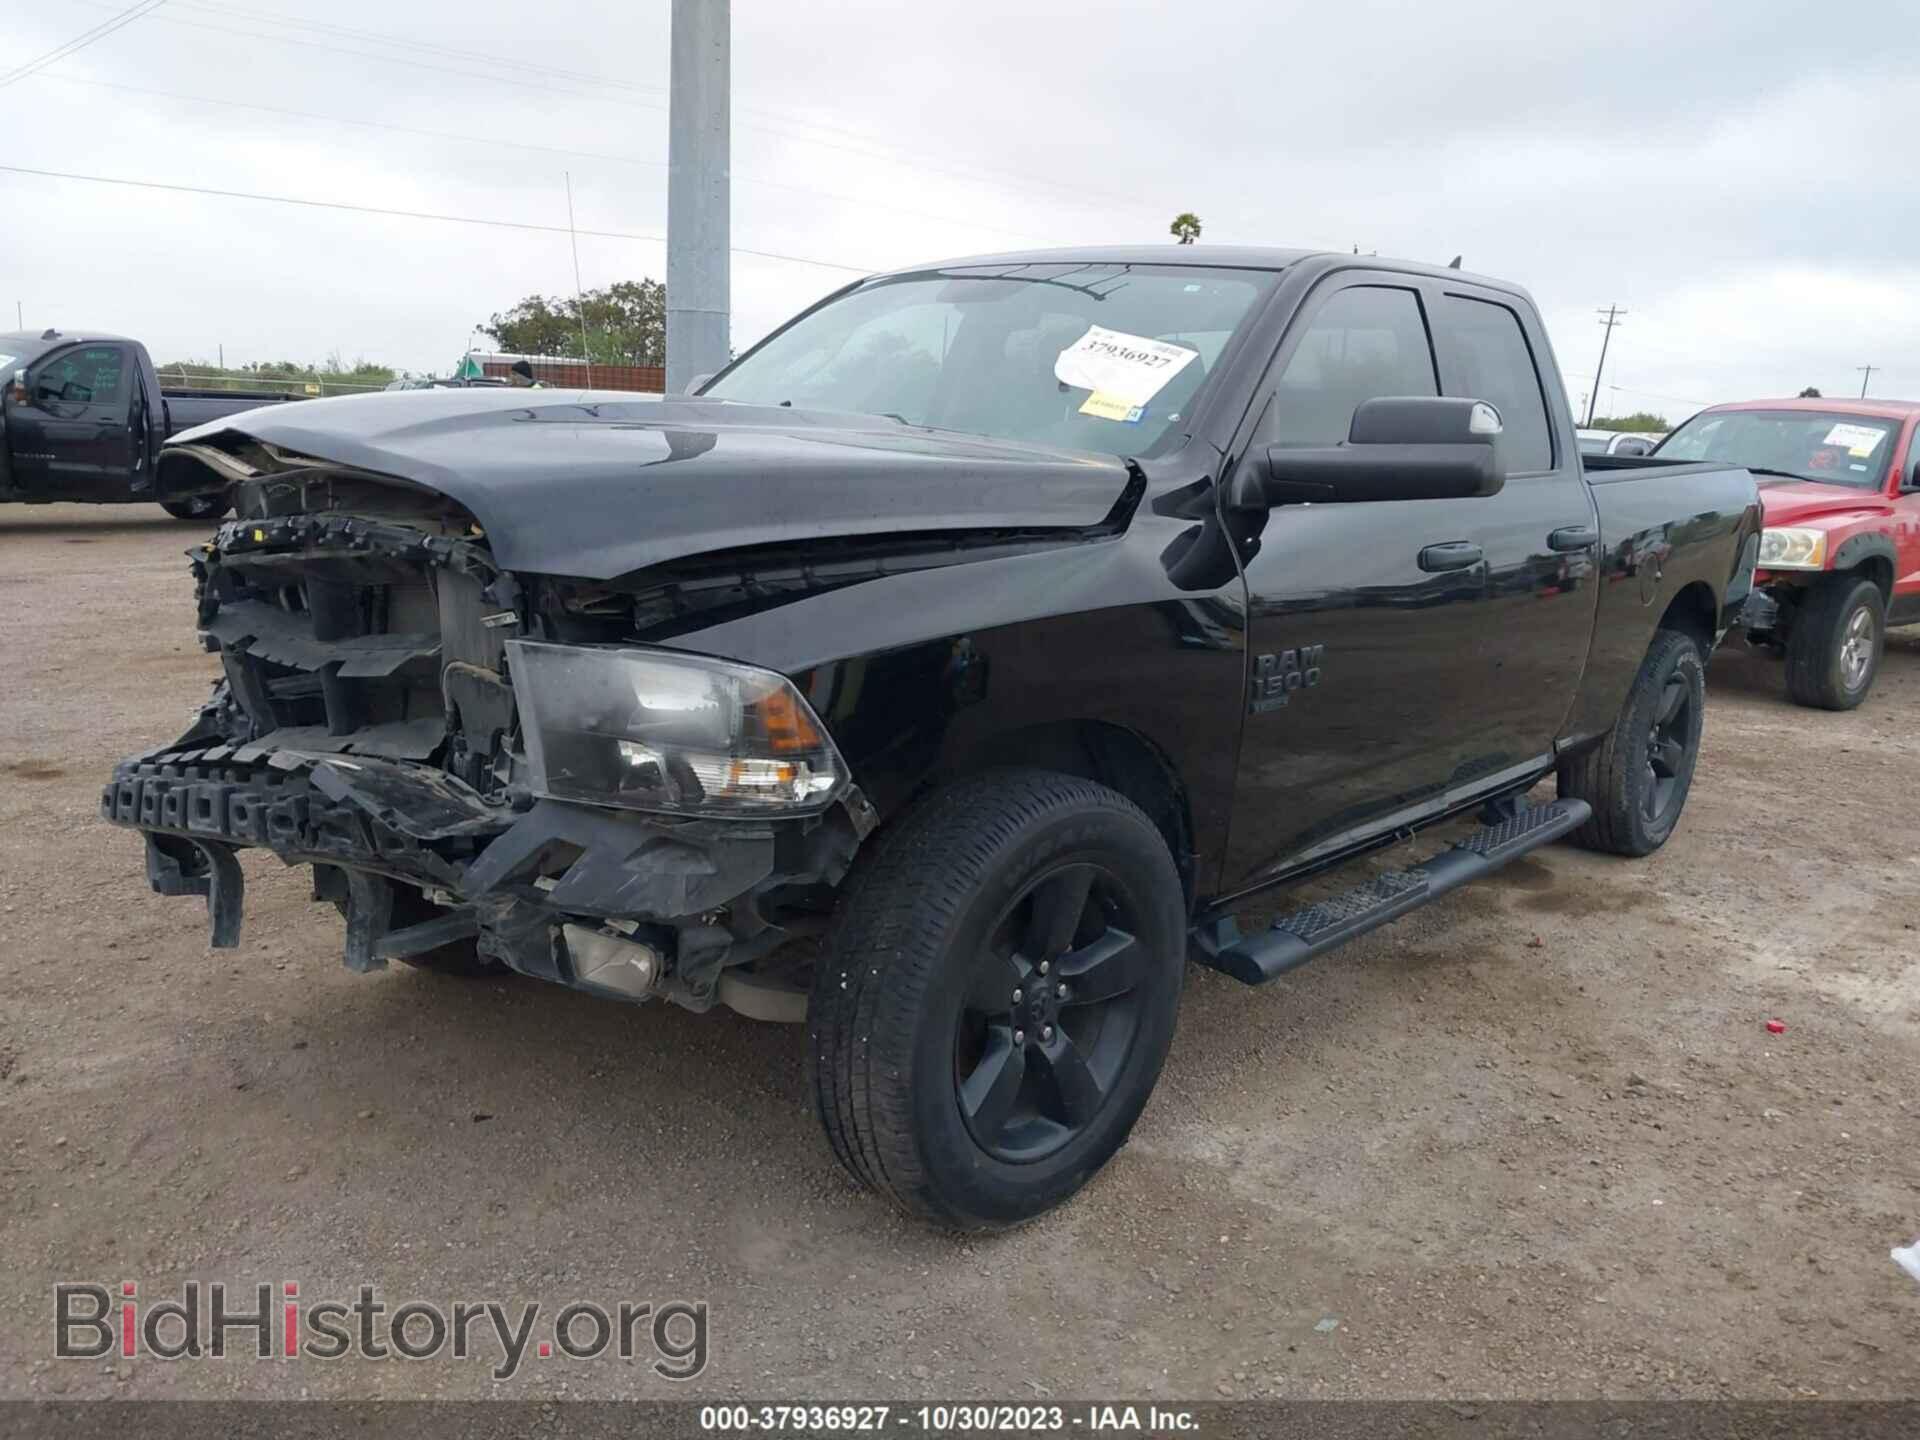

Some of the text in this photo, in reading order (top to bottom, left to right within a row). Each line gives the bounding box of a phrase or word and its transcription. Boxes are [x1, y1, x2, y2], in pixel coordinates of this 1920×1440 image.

[1081, 340, 1172, 369] 37936927
[1256, 643, 1325, 677] RAM
[1254, 666, 1321, 698] 1500
